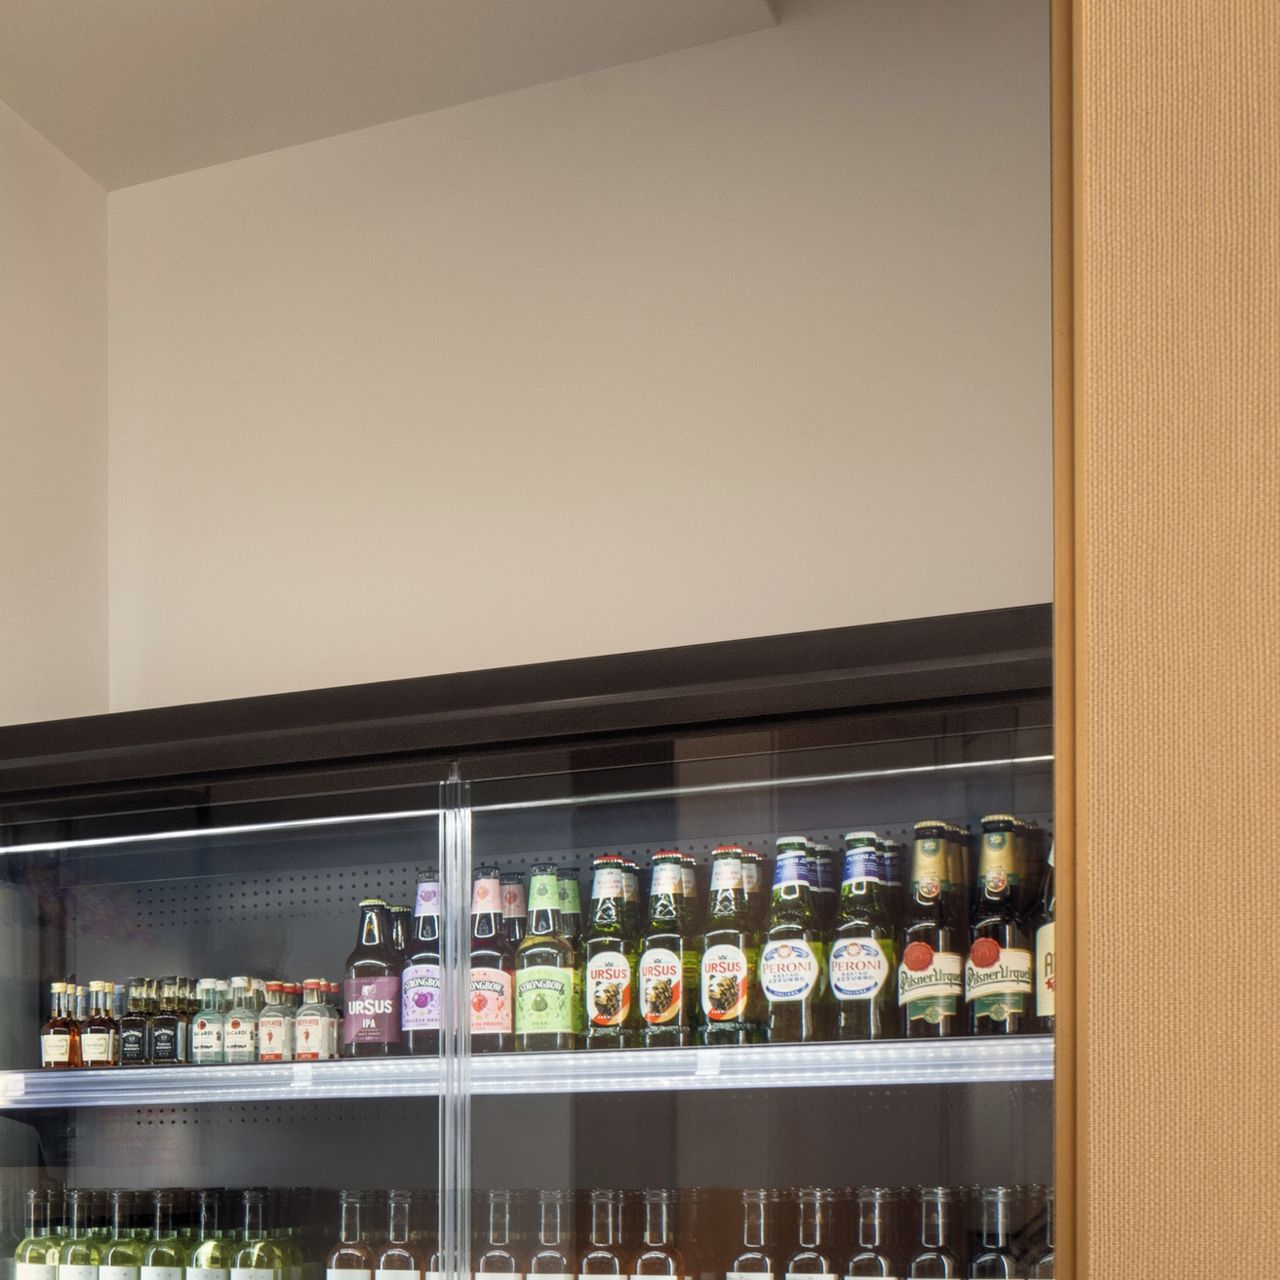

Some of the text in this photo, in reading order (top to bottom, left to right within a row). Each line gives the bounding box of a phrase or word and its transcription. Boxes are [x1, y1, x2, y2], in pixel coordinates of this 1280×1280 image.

[642, 964, 676, 977] URSUS
[704, 961, 740, 973] URSUS
[762, 962, 811, 975] PERONI
[831, 959, 880, 973] PERONI
[590, 967, 627, 980] URSUS
[933, 967, 961, 988] Urque
[348, 1000, 393, 1015] URSUS
[362, 1019, 376, 1029] IPA
